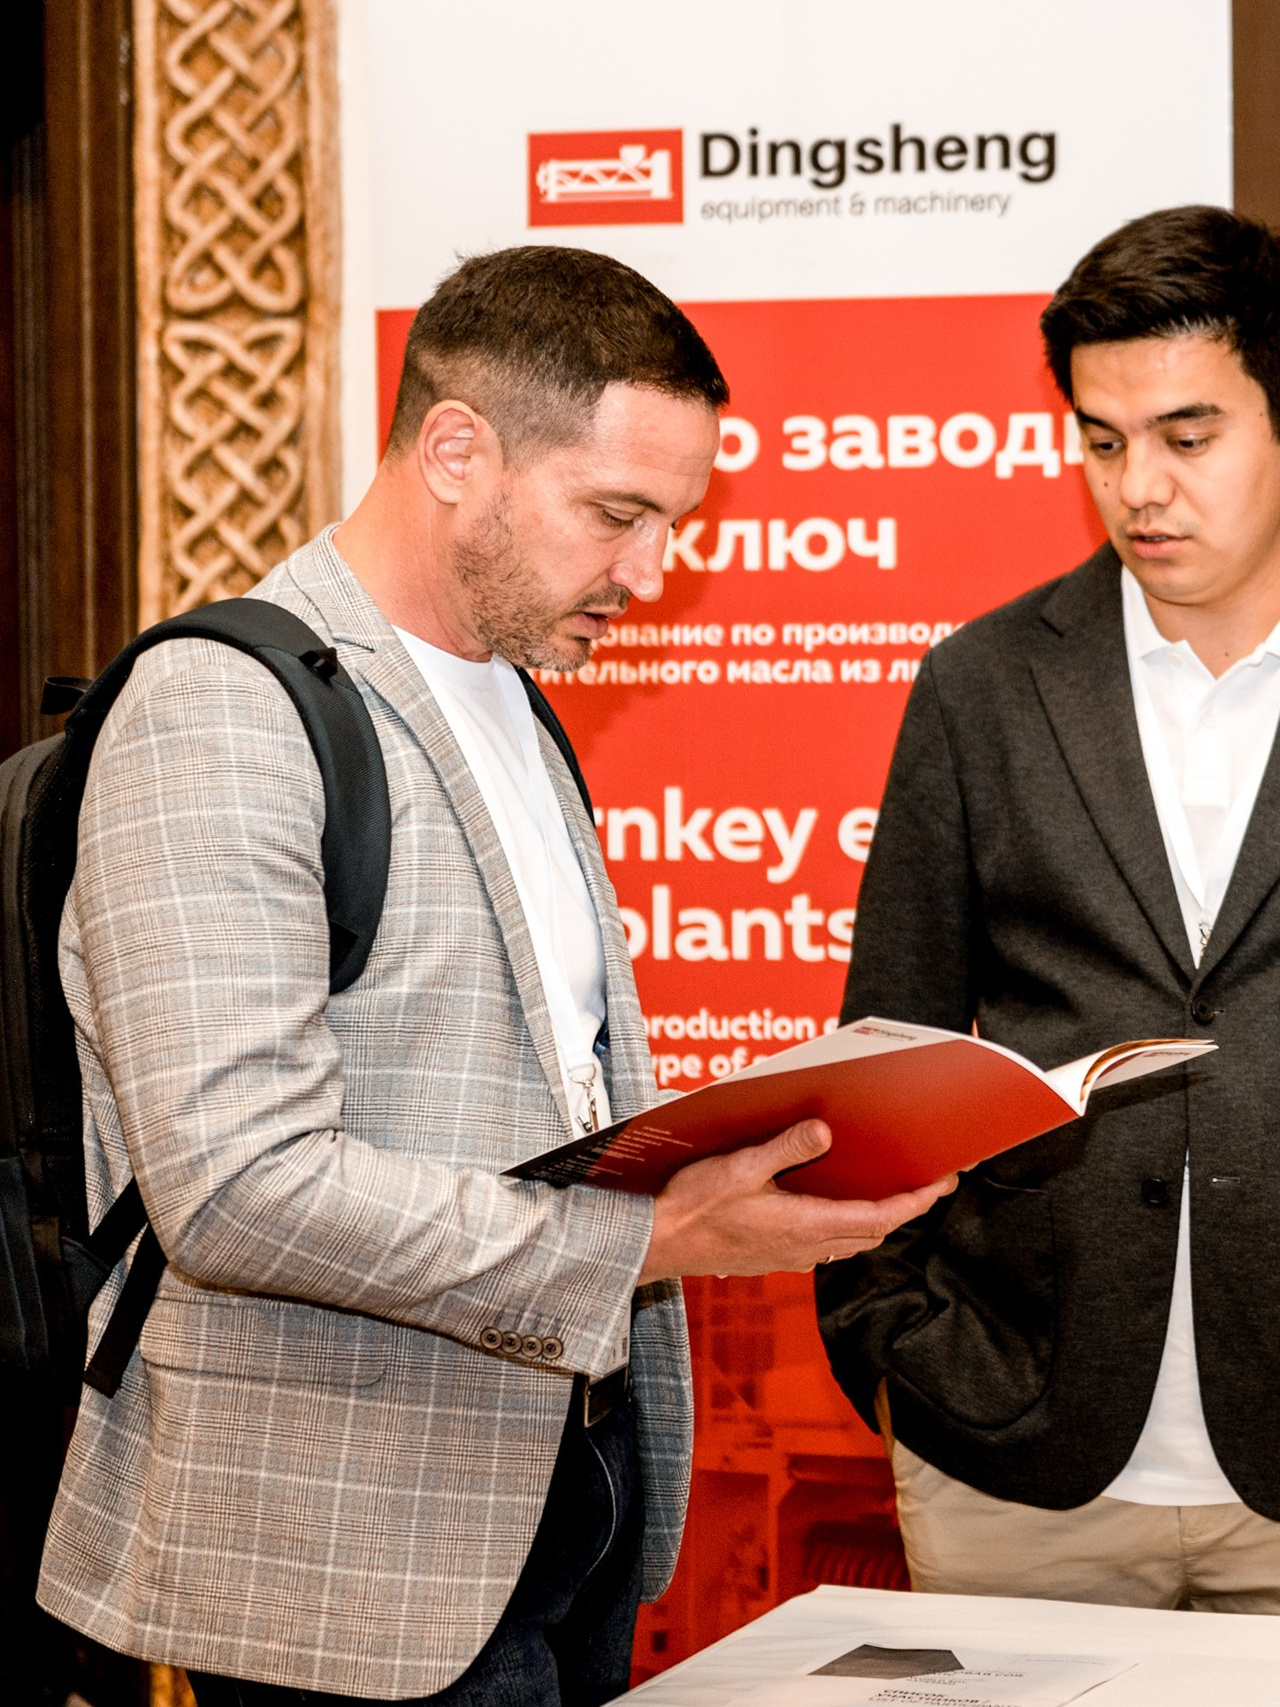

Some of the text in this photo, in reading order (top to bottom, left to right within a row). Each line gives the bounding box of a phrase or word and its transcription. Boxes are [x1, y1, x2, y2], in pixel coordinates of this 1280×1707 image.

[700, 123, 1056, 190] Dingsheng
[701, 190, 1012, 223] equipment & machinery
[662, 518, 897, 572] ключ
[591, 621, 965, 653] ование по производ
[727, 658, 832, 684] масла
[840, 659, 881, 683] из
